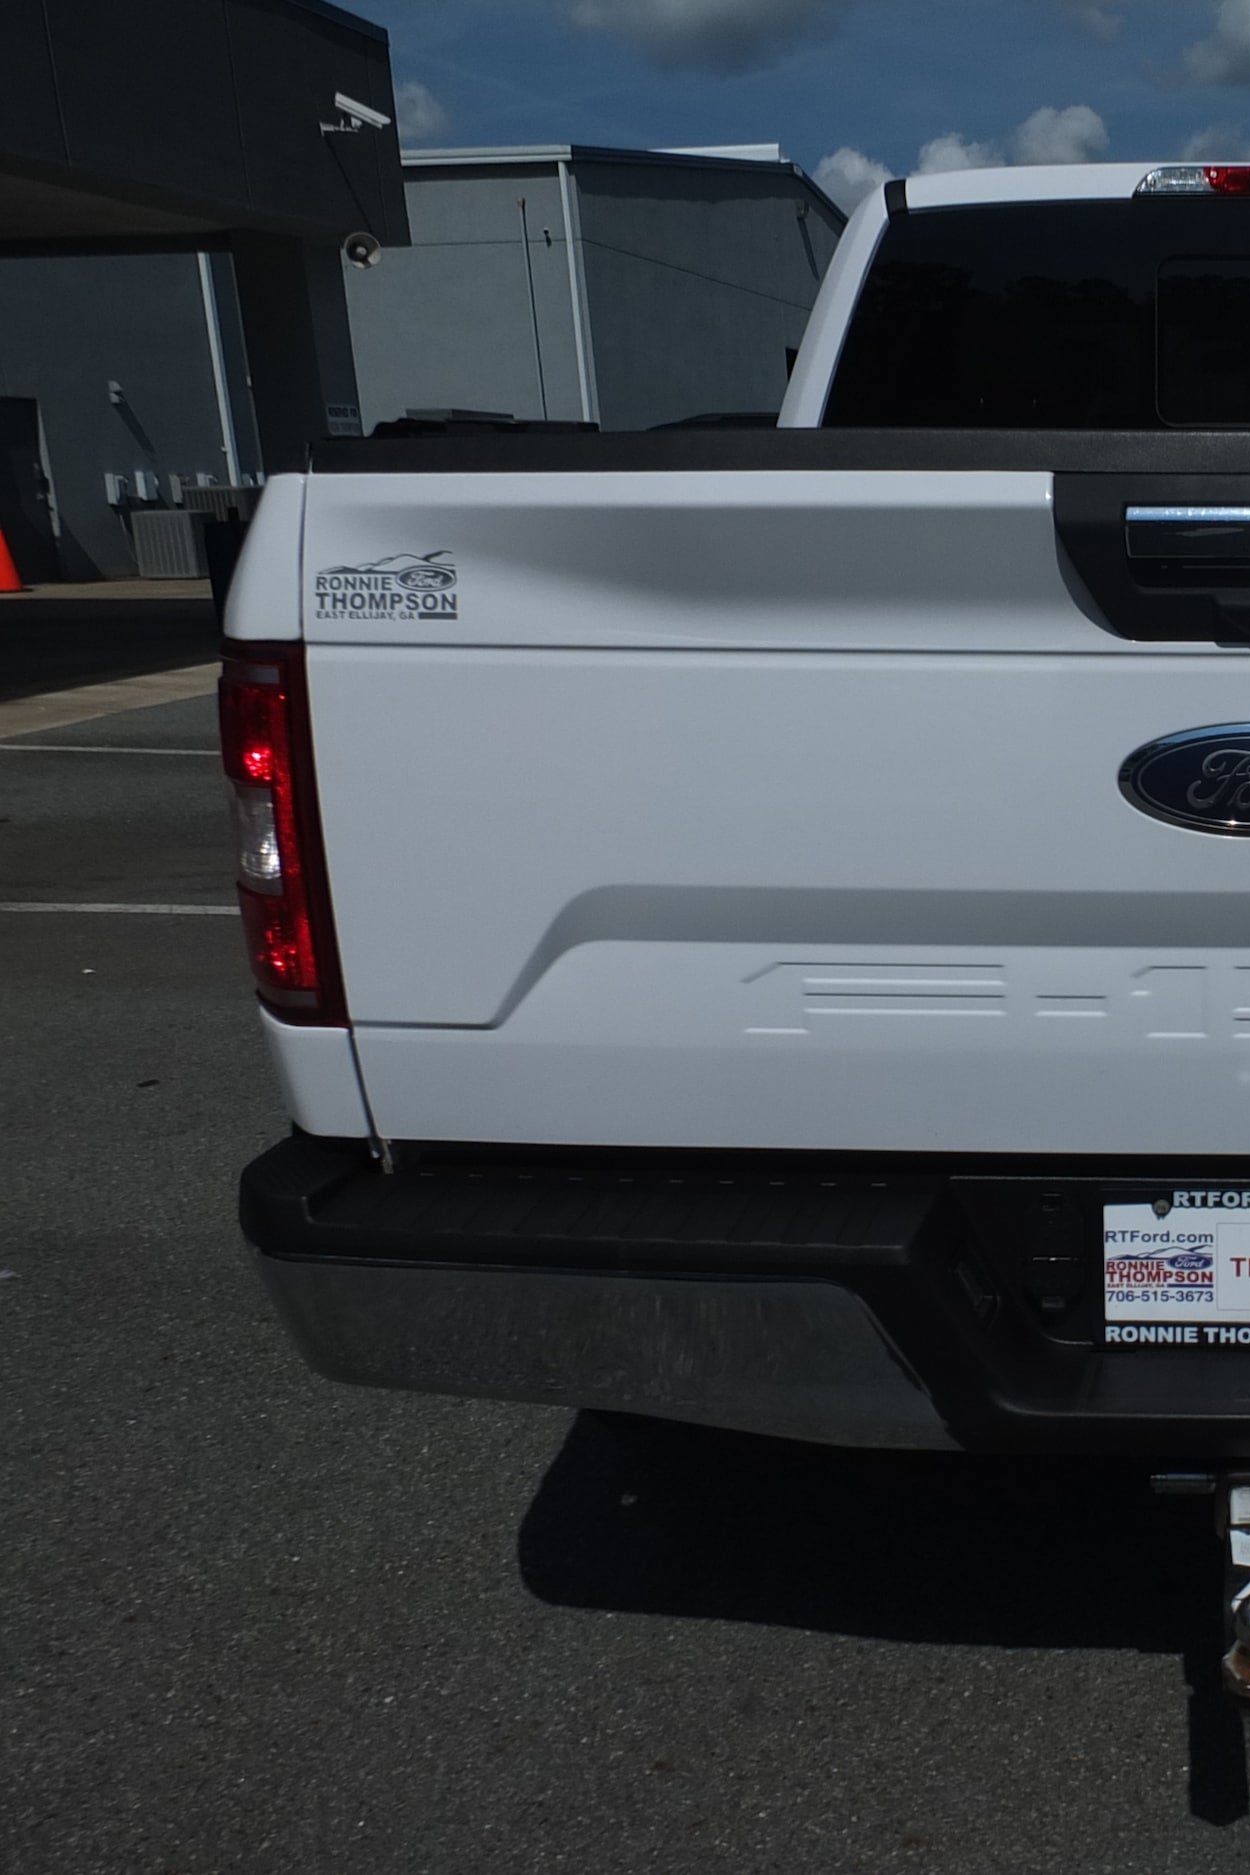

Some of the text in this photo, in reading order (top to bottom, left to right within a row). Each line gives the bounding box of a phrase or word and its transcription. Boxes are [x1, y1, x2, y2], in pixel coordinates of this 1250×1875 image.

[316, 576, 392, 591] RONNIE
[315, 593, 457, 611] THOMPSON
[316, 611, 345, 620] EAST
[400, 611, 415, 620] GA
[1105, 1230, 1213, 1243] RTFord.com
[1106, 1261, 1165, 1271] RONNIE
[1105, 1271, 1213, 1283] THOMPSON
[1106, 1290, 1214, 1302] 706-515-3673
[1105, 1326, 1198, 1343] RONNIE
